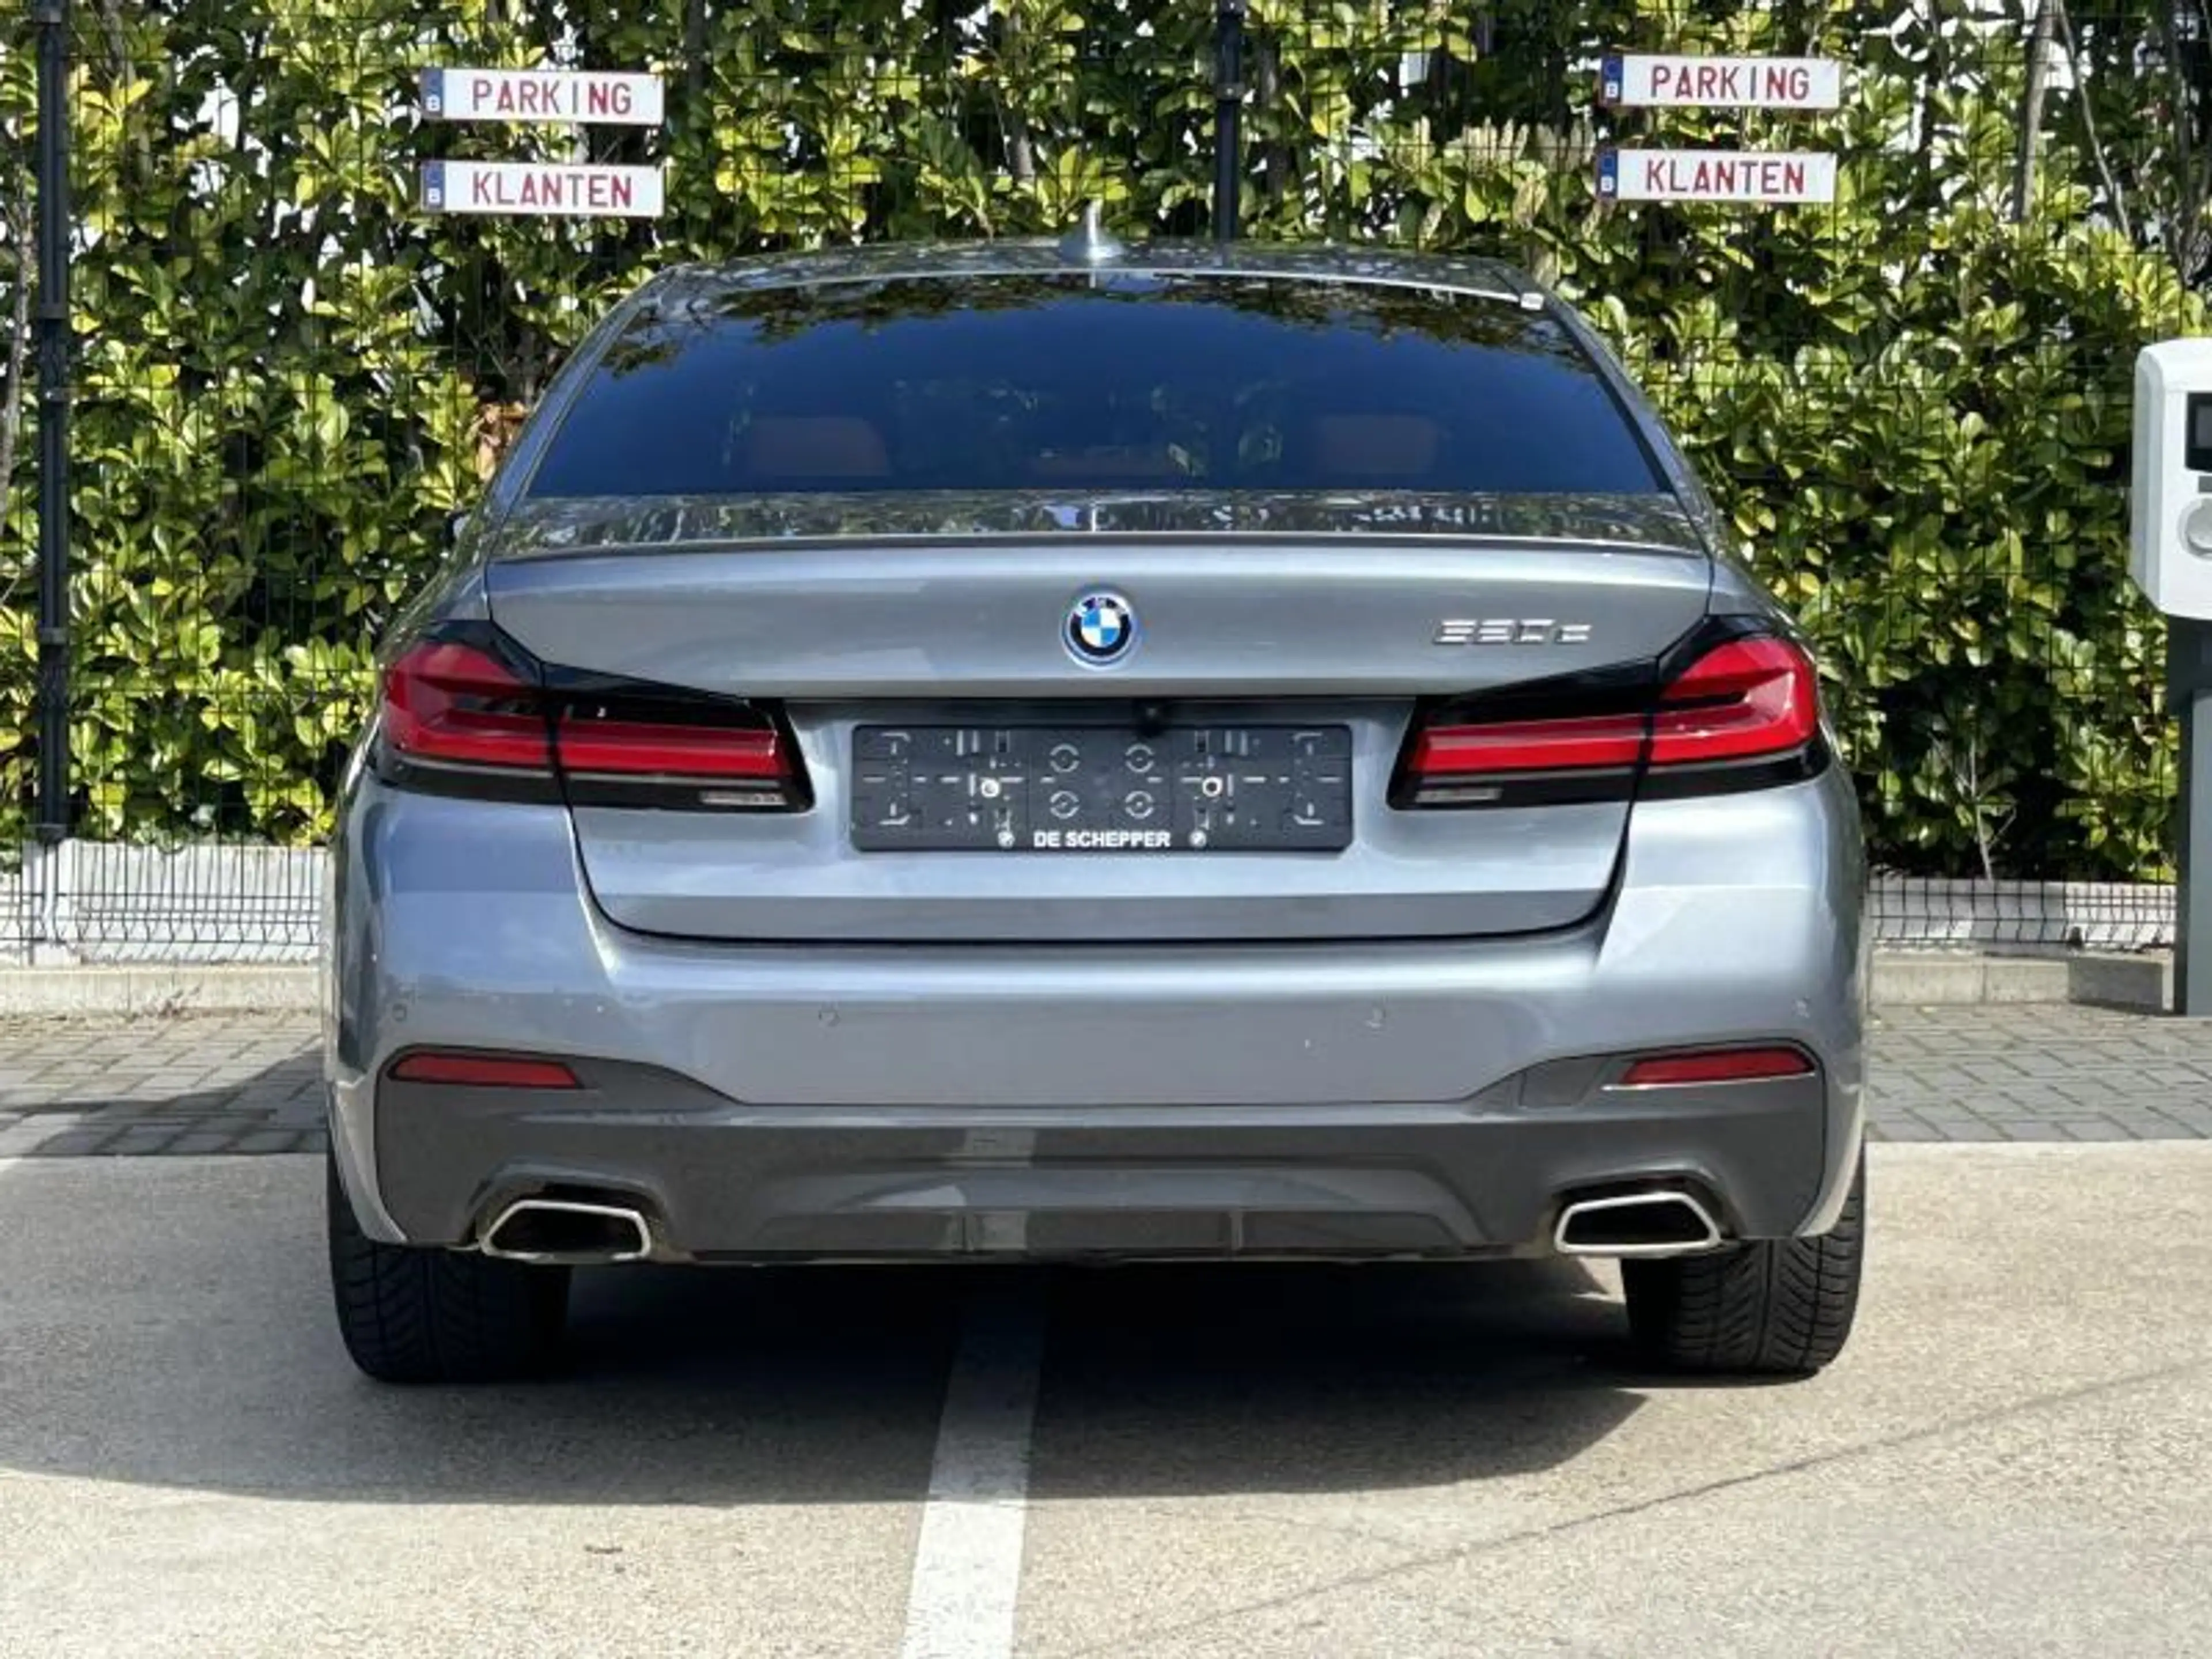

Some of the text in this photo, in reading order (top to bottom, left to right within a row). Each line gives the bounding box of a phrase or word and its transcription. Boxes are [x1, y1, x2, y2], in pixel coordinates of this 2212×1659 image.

[472, 79, 631, 115] PARKING
[1651, 65, 1809, 100] PARKING
[472, 172, 632, 208] KLANTEN
[1646, 160, 1804, 195] KLANTEN
[1033, 831, 1172, 847] DE SCHEPPER
